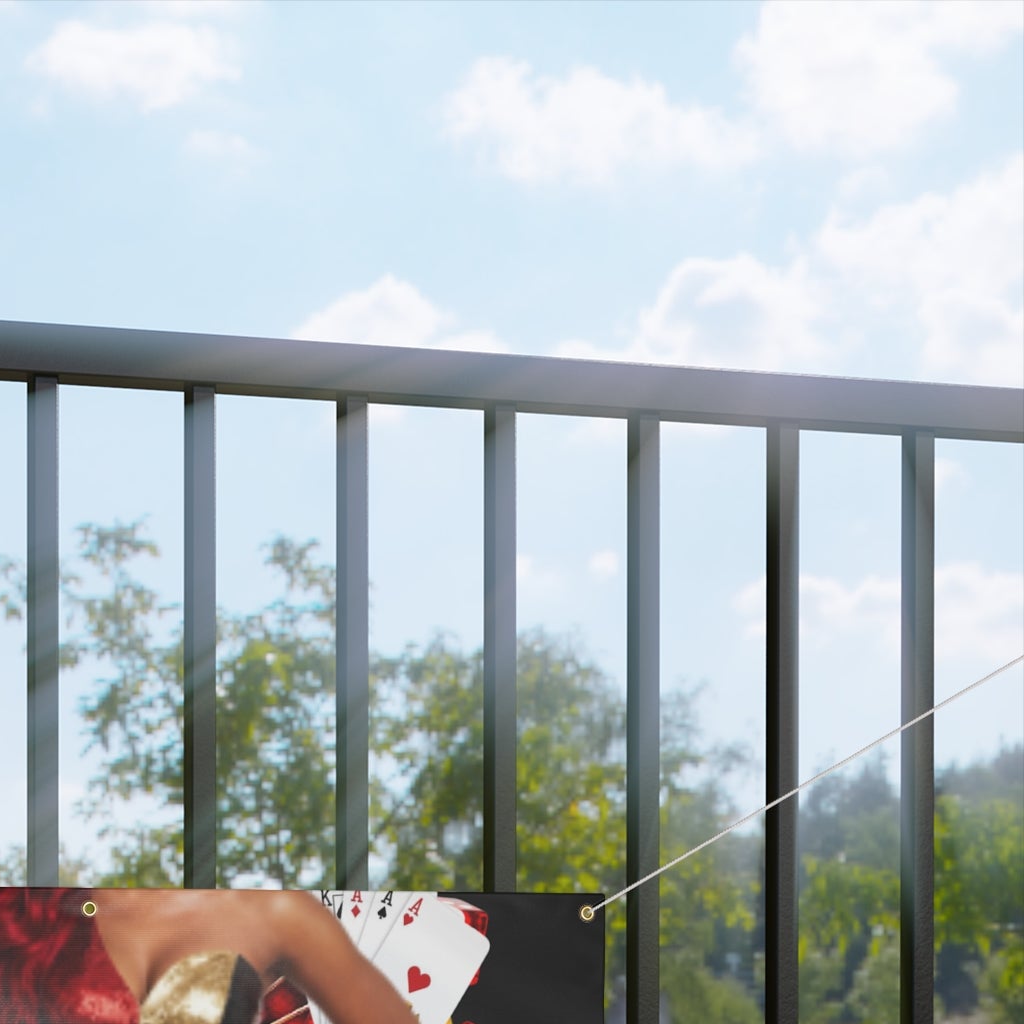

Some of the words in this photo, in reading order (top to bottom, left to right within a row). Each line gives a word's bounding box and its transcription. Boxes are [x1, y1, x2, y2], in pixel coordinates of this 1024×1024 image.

[351, 890, 363, 903] A
[381, 891, 393, 907] A
[408, 897, 424, 916] A
